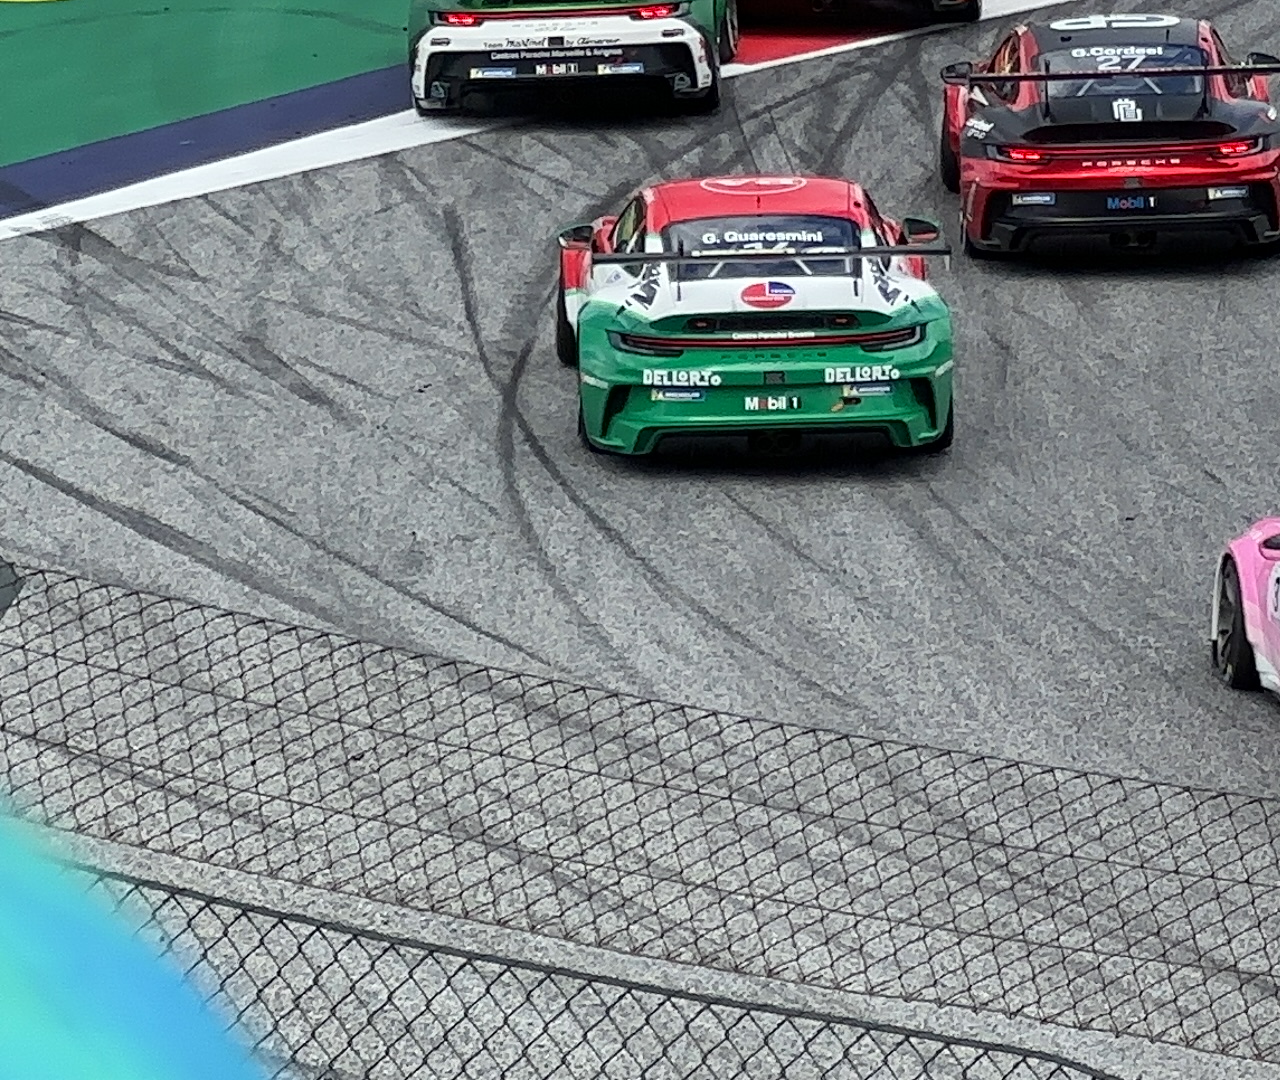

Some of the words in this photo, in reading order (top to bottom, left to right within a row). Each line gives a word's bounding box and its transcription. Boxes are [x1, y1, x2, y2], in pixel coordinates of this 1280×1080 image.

[1095, 54, 1148, 71] 27
[1107, 197, 1144, 210] Mobil
[702, 233, 720, 245] G.
[724, 230, 823, 243] Quaresmini
[744, 396, 787, 410] Mobil
